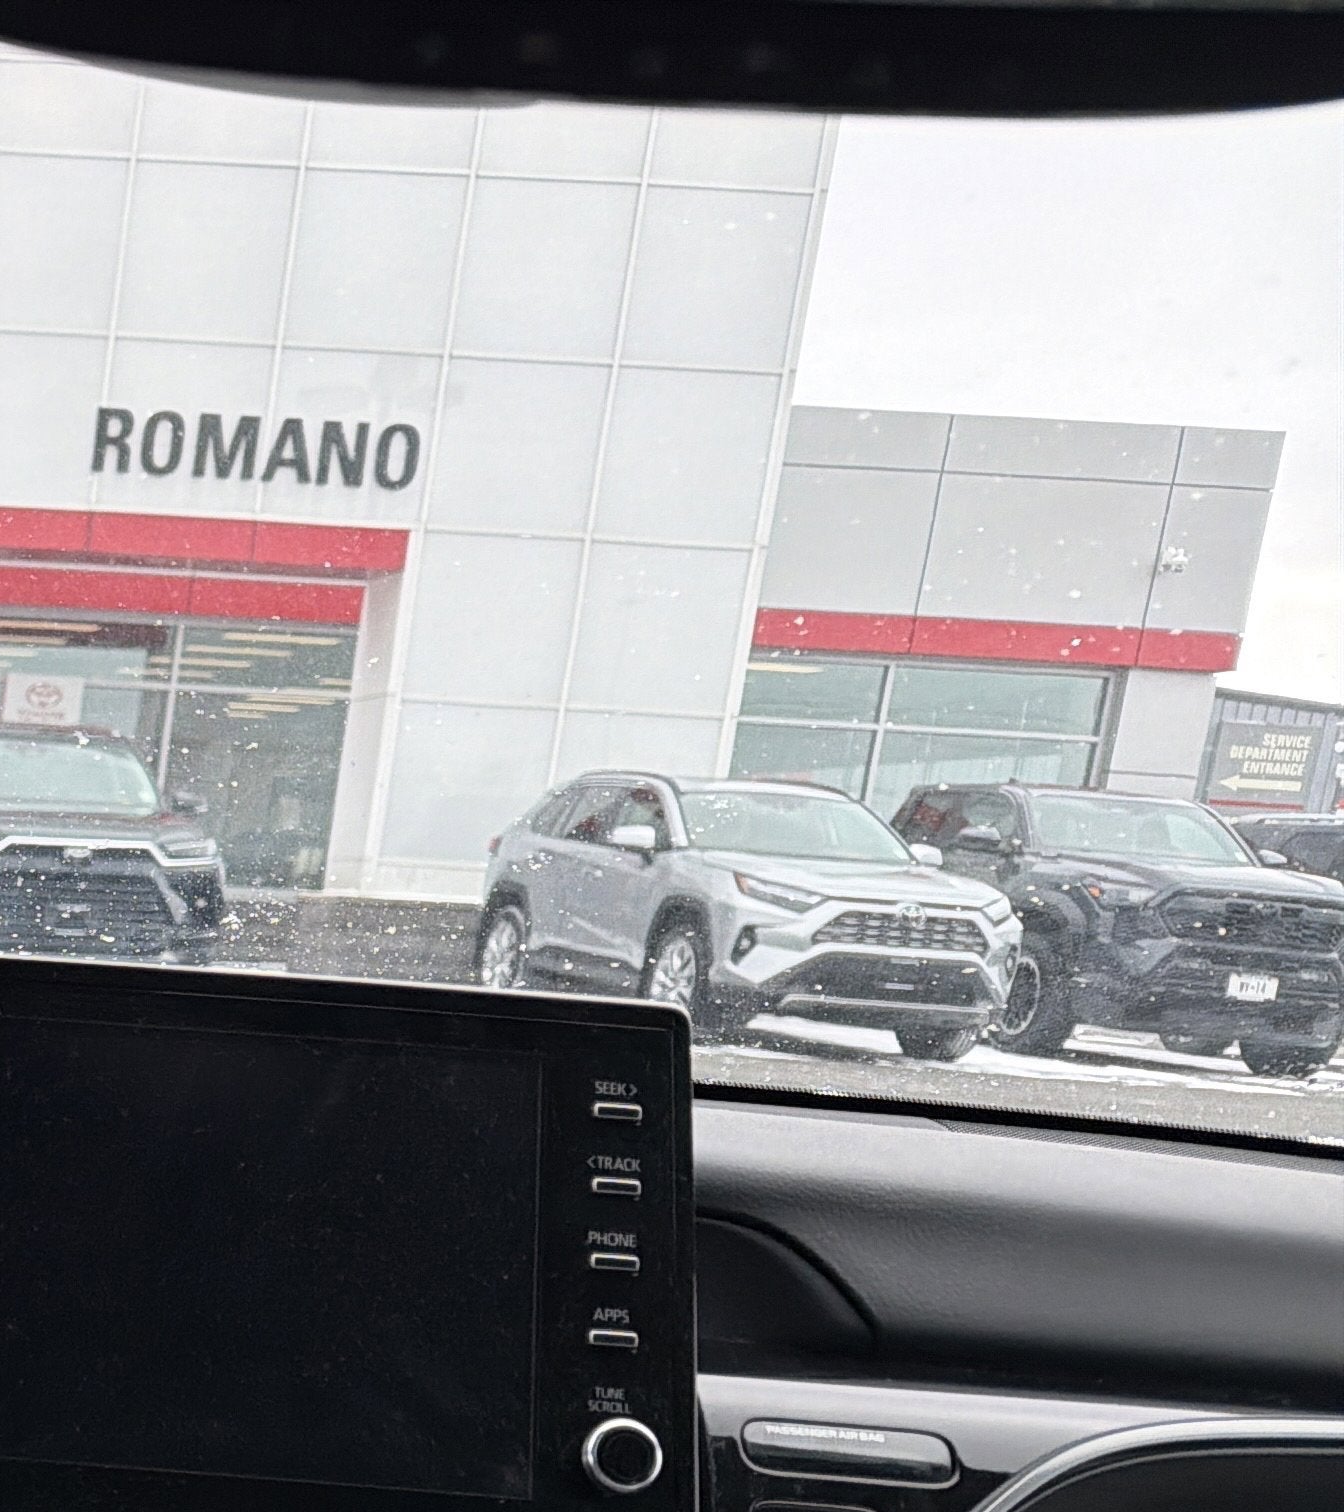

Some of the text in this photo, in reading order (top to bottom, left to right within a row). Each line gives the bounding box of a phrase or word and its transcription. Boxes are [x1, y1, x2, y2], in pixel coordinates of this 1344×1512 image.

[90, 406, 421, 491] ROMANO
[1262, 733, 1313, 749] SERVICE
[1229, 745, 1309, 763] DEPARTMENT
[1242, 762, 1306, 777] ENTRANCE
[587, 1231, 638, 1249] PHONE
[593, 1308, 631, 1324] APPS
[594, 1387, 626, 1400] TUNE
[587, 1400, 633, 1415] SCROLL
[764, 1425, 837, 1438] PASSENGER
